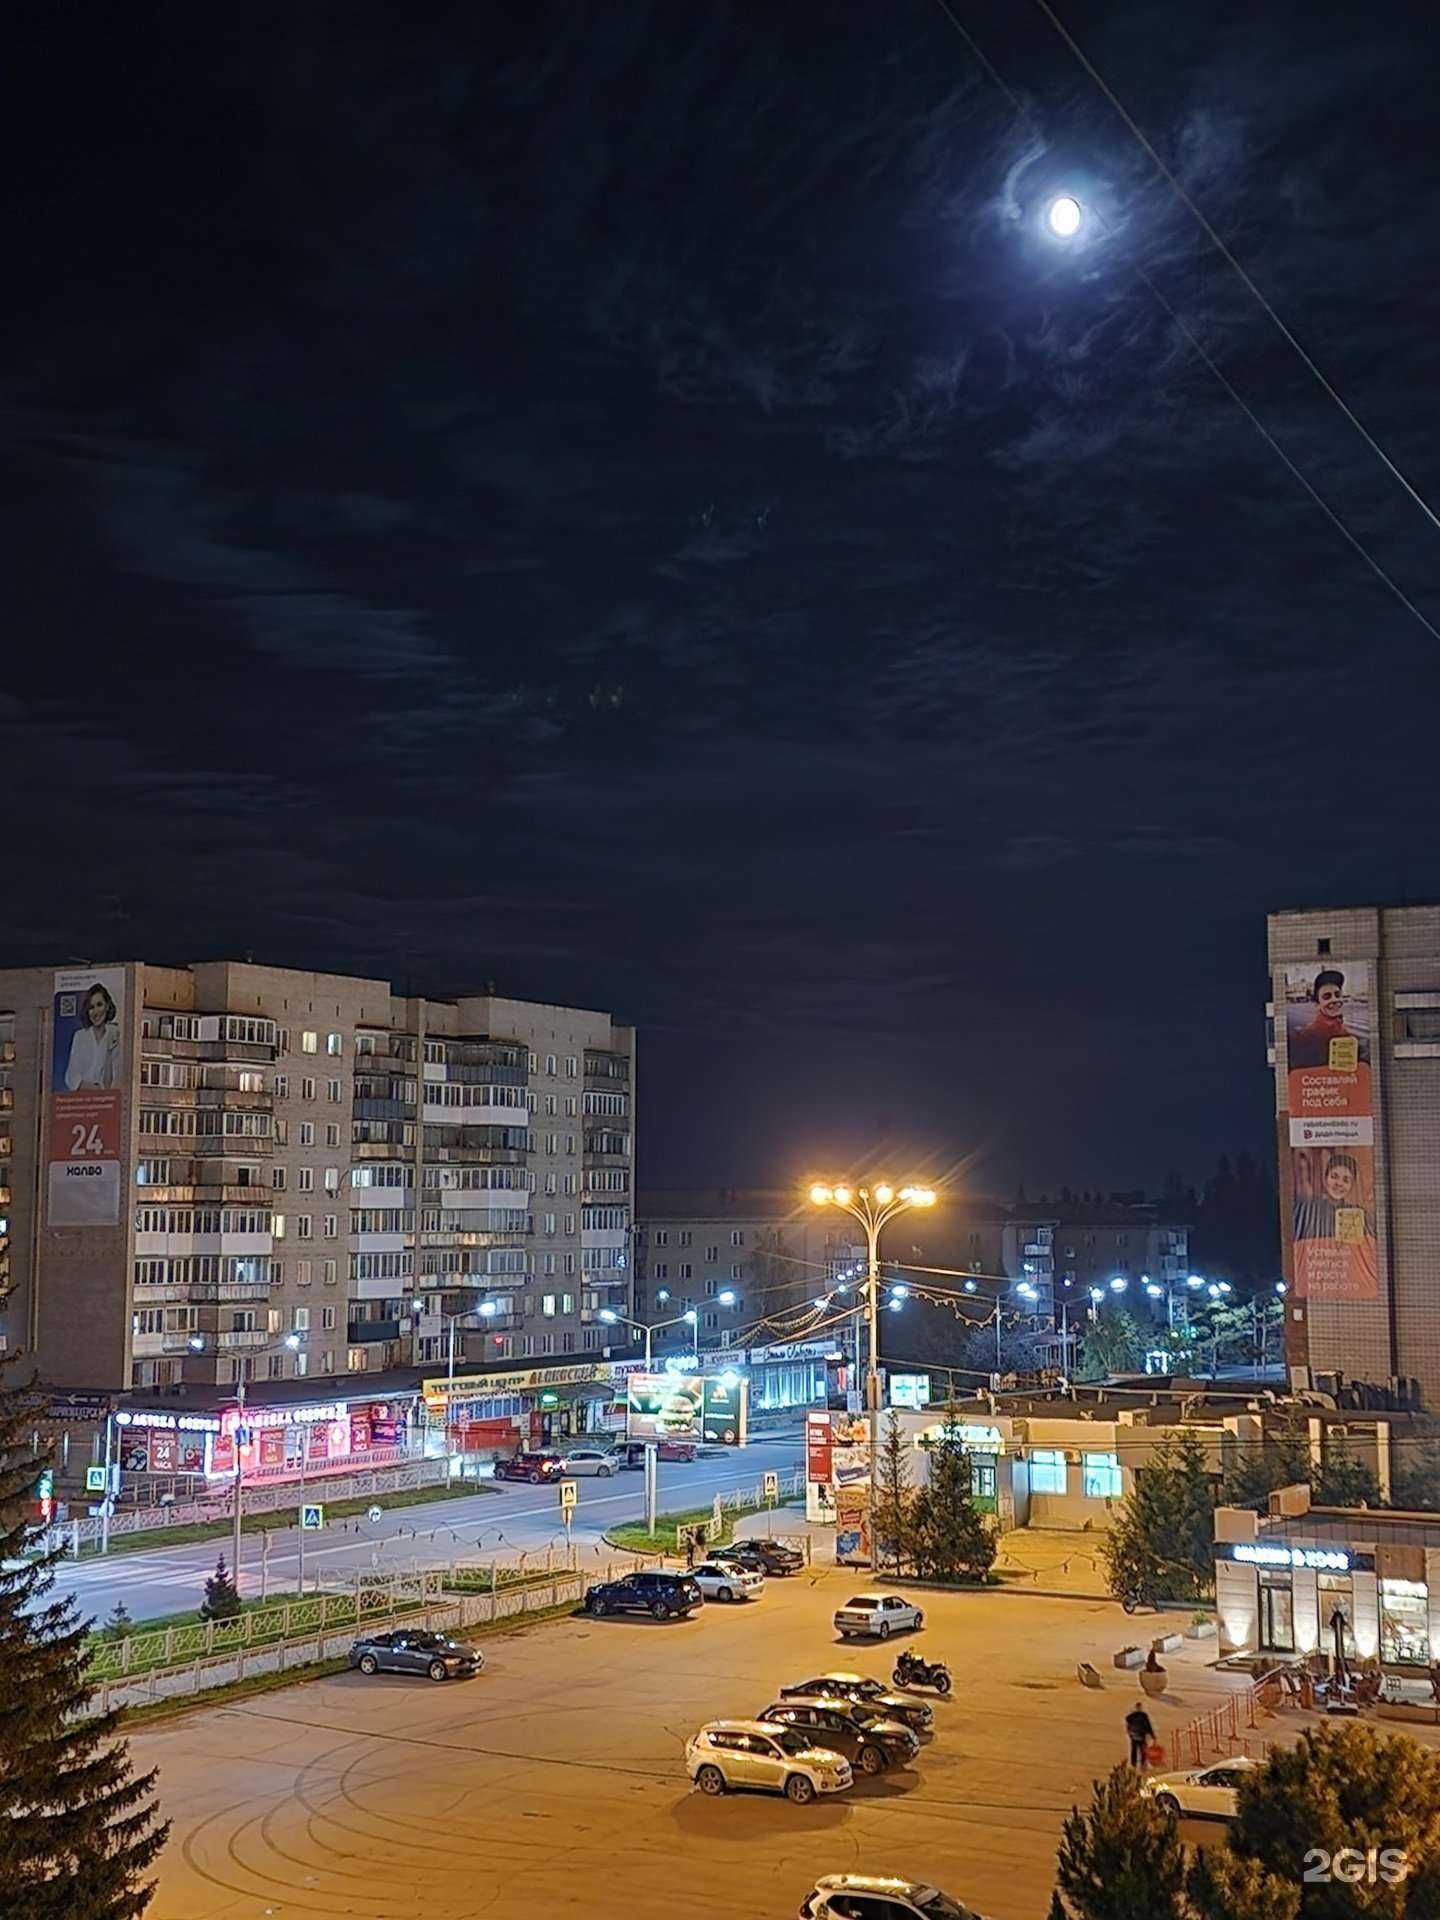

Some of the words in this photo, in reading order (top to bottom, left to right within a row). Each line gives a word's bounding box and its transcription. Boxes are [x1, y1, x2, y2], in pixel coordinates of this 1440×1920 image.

[1301, 1074, 1358, 1086] Составляй
[1301, 1086, 1340, 1098] график
[1301, 1099, 1322, 1108] под
[71, 1124, 104, 1156] 24
[156, 1447, 171, 1460] 24
